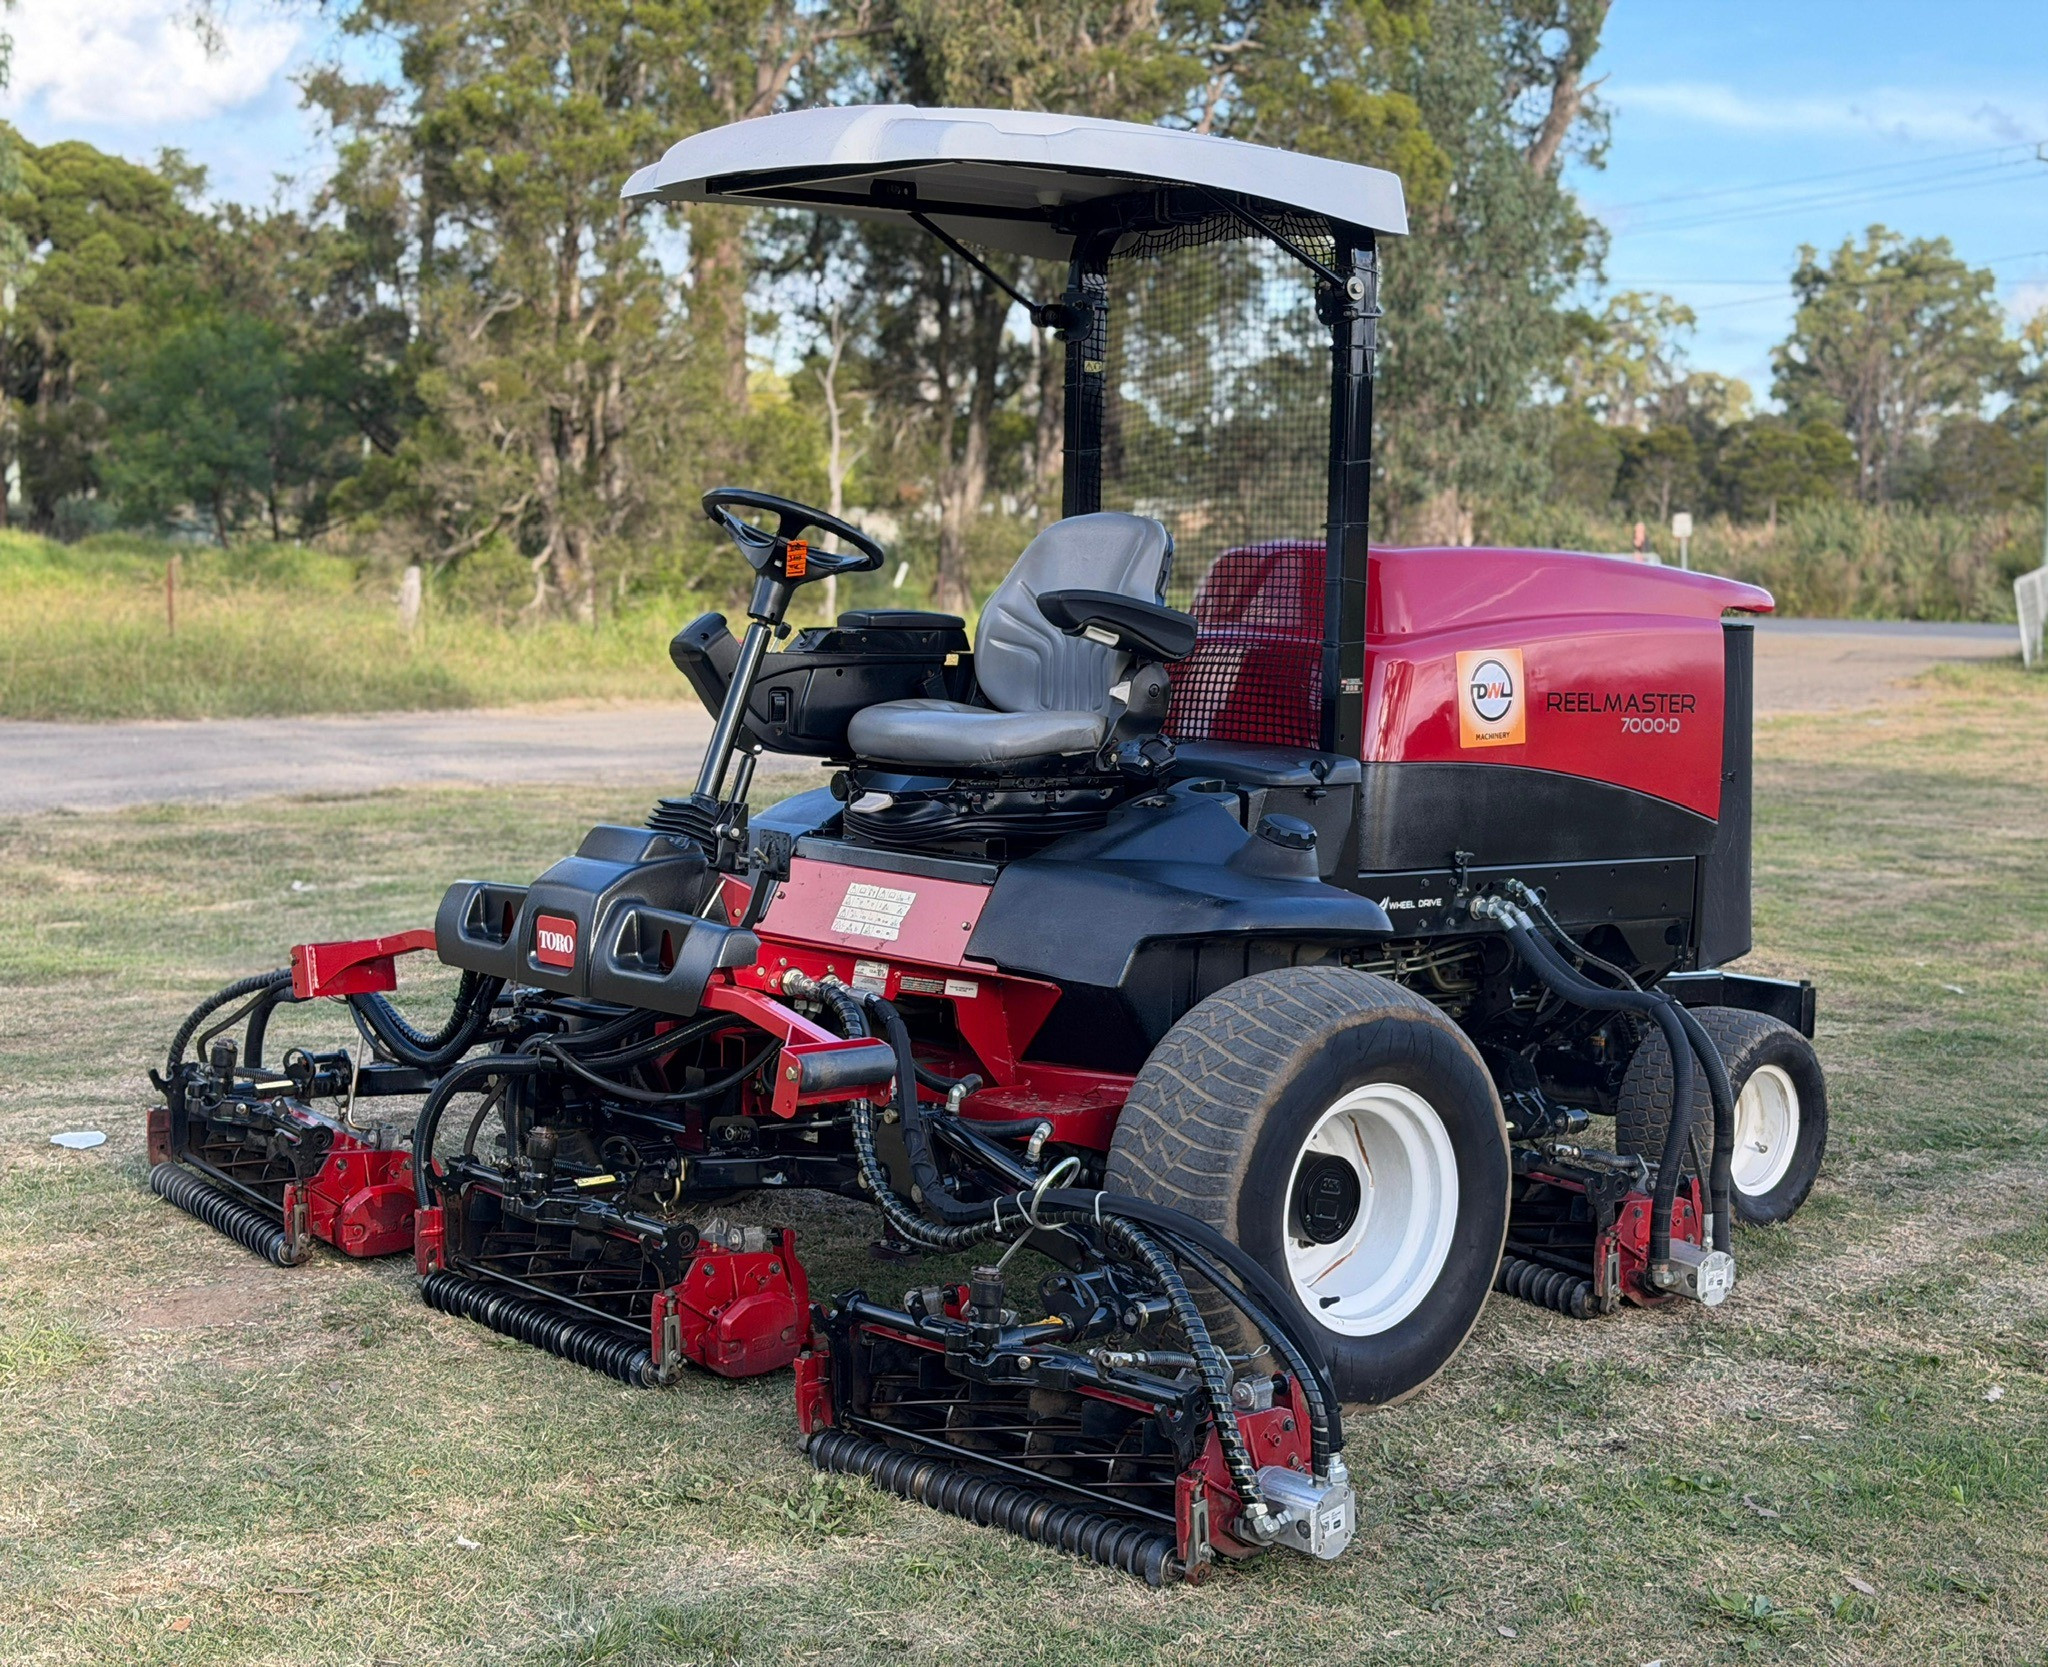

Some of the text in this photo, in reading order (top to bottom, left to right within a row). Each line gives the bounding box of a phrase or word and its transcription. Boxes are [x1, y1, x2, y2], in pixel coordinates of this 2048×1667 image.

[1471, 682, 1512, 699] DWL
[1546, 692, 1697, 714] REELMASTER
[1475, 731, 1511, 741] MACHINERY
[1389, 901, 1416, 910] WHEEL
[1418, 898, 1442, 908] DRIVE
[538, 930, 574, 954] TORO
